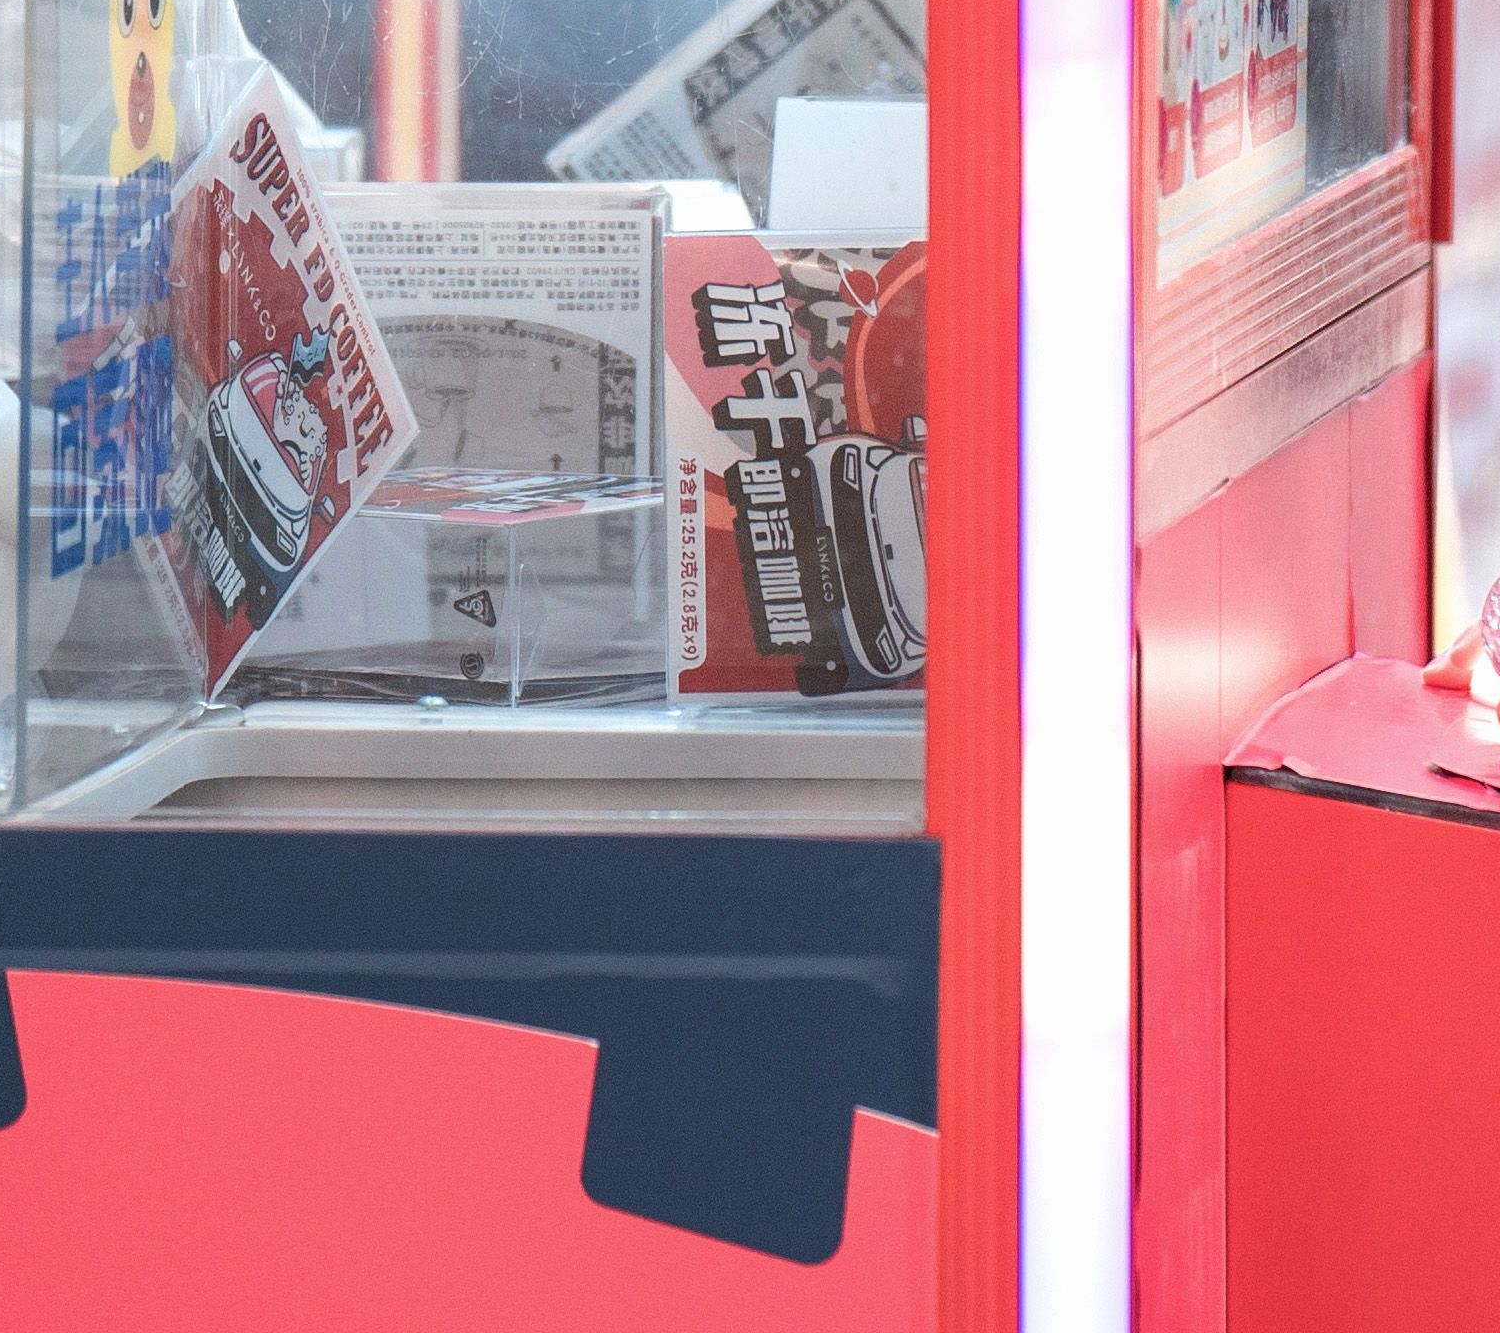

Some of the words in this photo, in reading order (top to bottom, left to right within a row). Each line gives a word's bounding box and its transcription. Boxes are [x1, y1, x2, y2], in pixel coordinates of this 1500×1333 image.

[229, 112, 310, 248] SUPER
[303, 241, 336, 304] FD
[328, 303, 395, 477] COFFEE
[355, 308, 377, 357] Control
